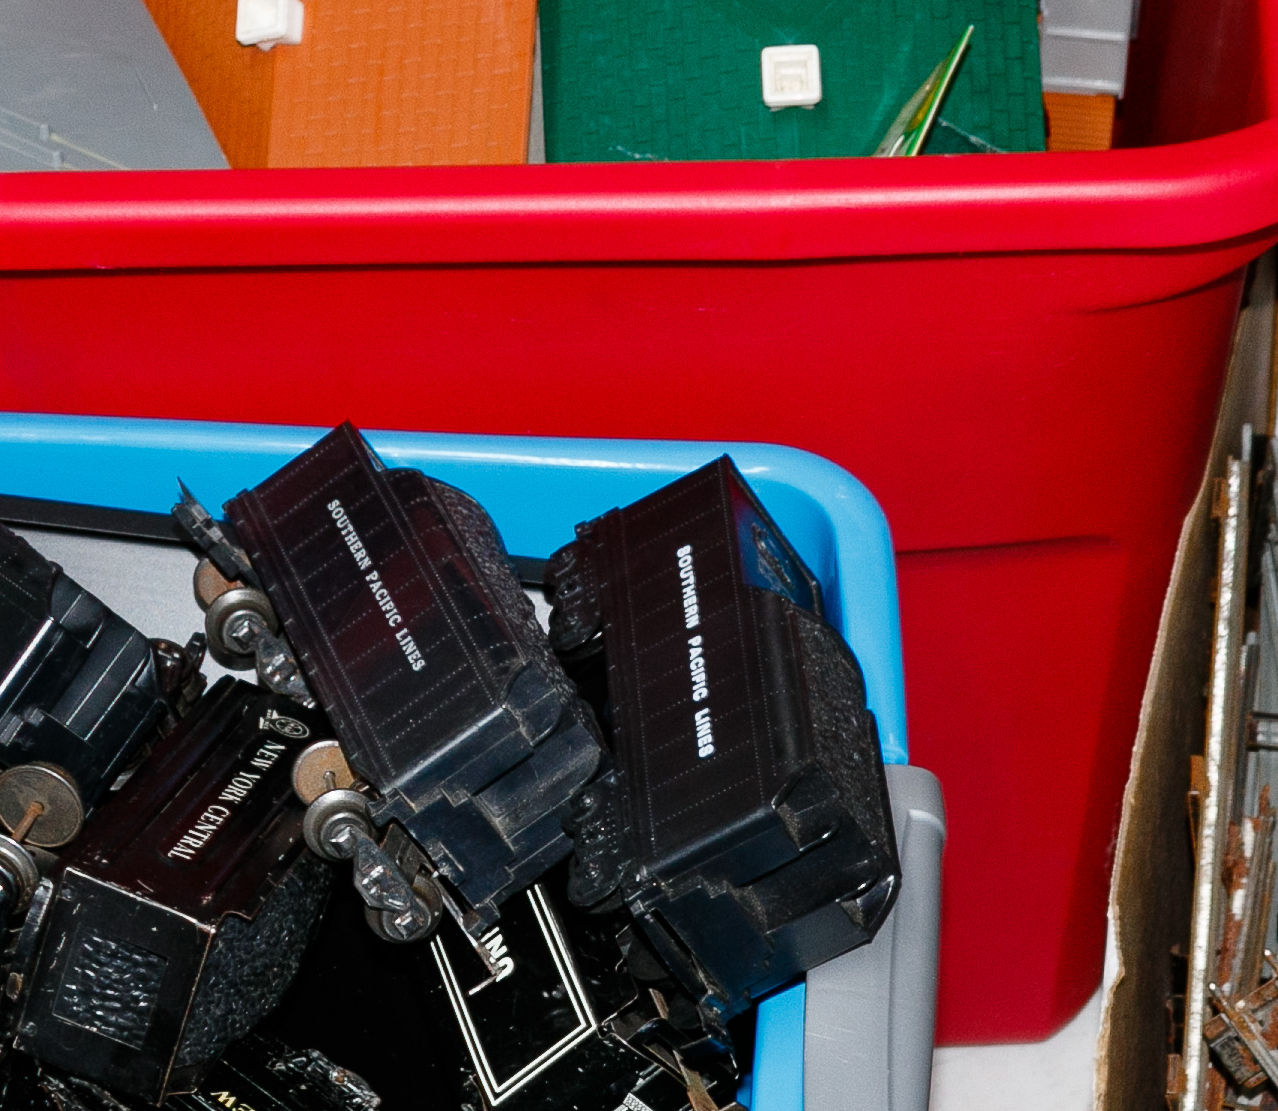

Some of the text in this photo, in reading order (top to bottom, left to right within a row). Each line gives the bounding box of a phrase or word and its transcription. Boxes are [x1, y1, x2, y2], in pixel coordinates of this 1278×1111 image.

[327, 499, 426, 672] SOUTHERN PACIFIC LINES
[676, 544, 715, 758] SOUTHERN PACIFIC LINES
[250, 740, 286, 771] NEW
[219, 771, 261, 804] YORK
[167, 805, 231, 860] CENTRAL
